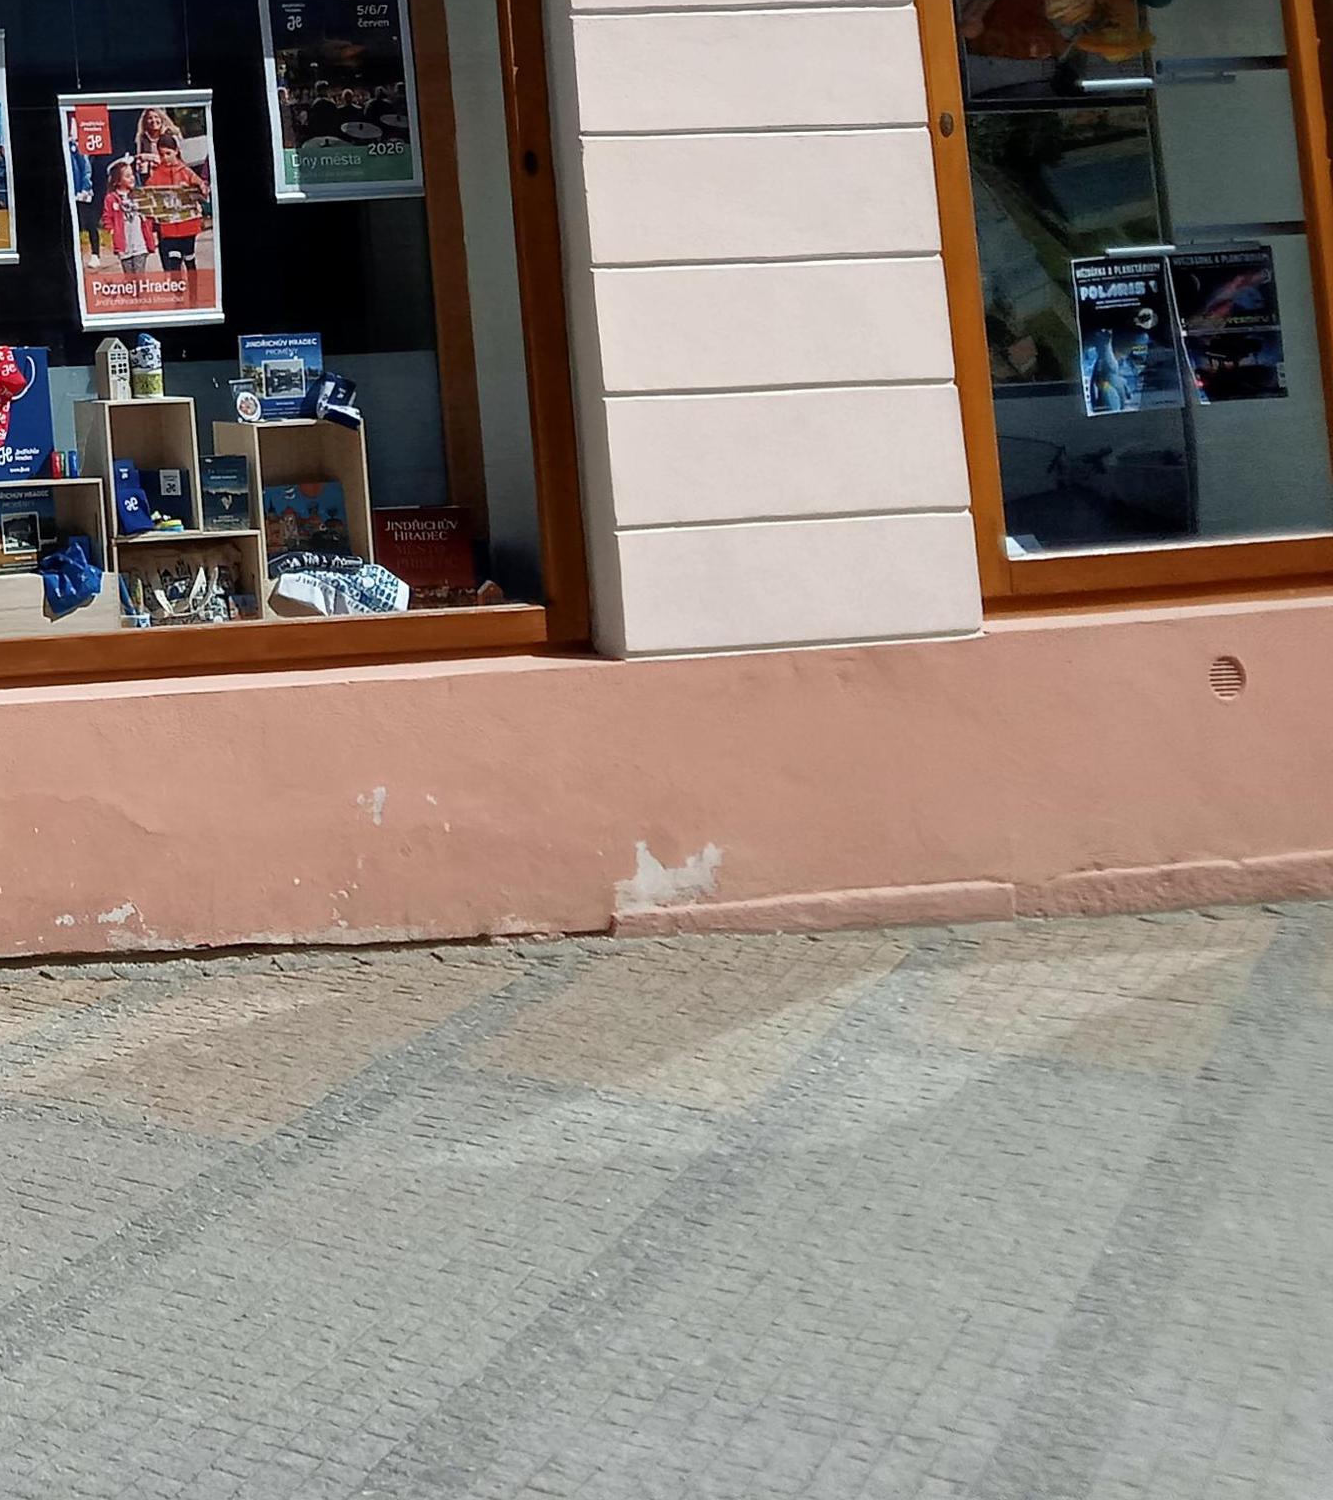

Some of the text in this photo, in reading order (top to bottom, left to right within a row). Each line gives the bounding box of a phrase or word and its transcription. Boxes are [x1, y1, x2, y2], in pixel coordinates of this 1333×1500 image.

[357, 17, 390, 28] červen
[367, 141, 404, 156] 2026
[92, 278, 187, 297] Poznej Hradec
[1079, 280, 1147, 302] POLARIS
[384, 517, 459, 532] JINDŘICHŮV
[394, 530, 449, 542] HRADEC
